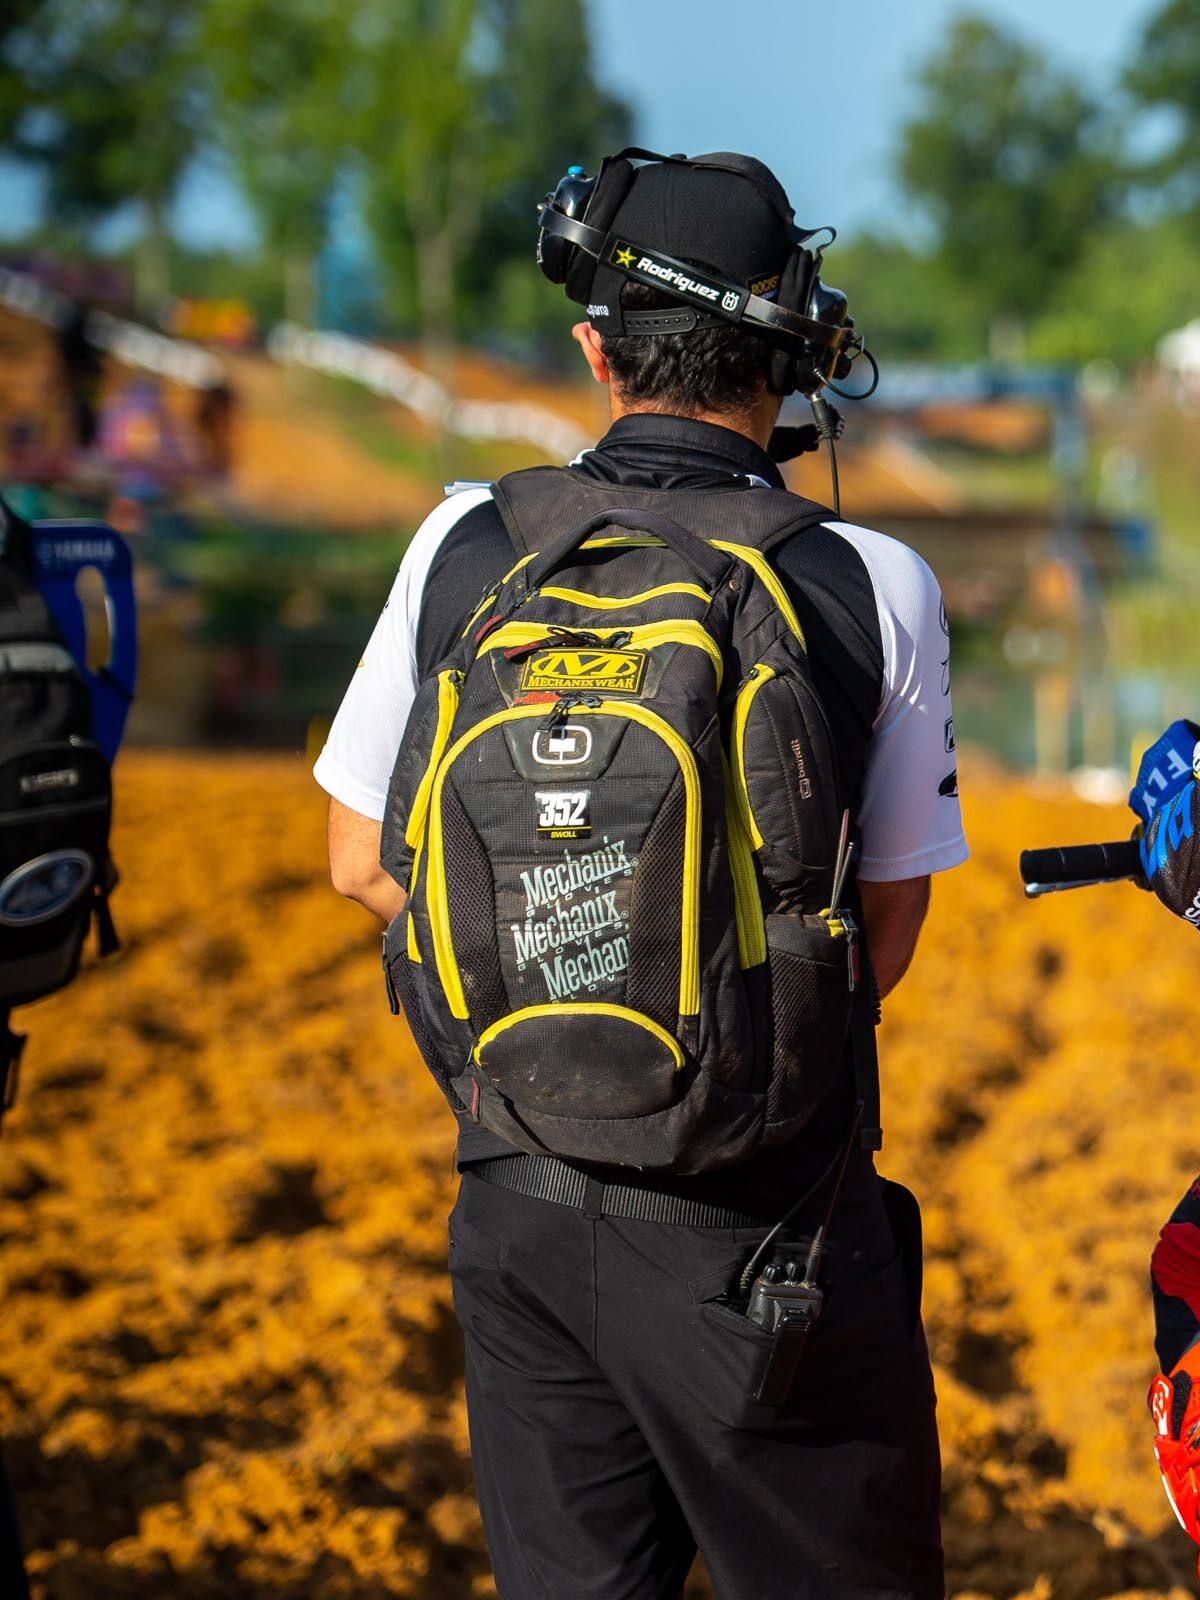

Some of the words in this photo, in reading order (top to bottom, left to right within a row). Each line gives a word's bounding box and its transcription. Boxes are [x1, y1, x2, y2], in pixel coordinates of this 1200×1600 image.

[636, 256, 721, 302] Rodriguez
[53, 538, 116, 561] YAMAHA
[528, 675, 593, 687] MECHANIX
[596, 677, 634, 689] WEAR
[535, 791, 587, 827] 352
[551, 831, 577, 839] SWOLL
[520, 836, 632, 912] Mechanix
[510, 886, 622, 965] Mechanix
